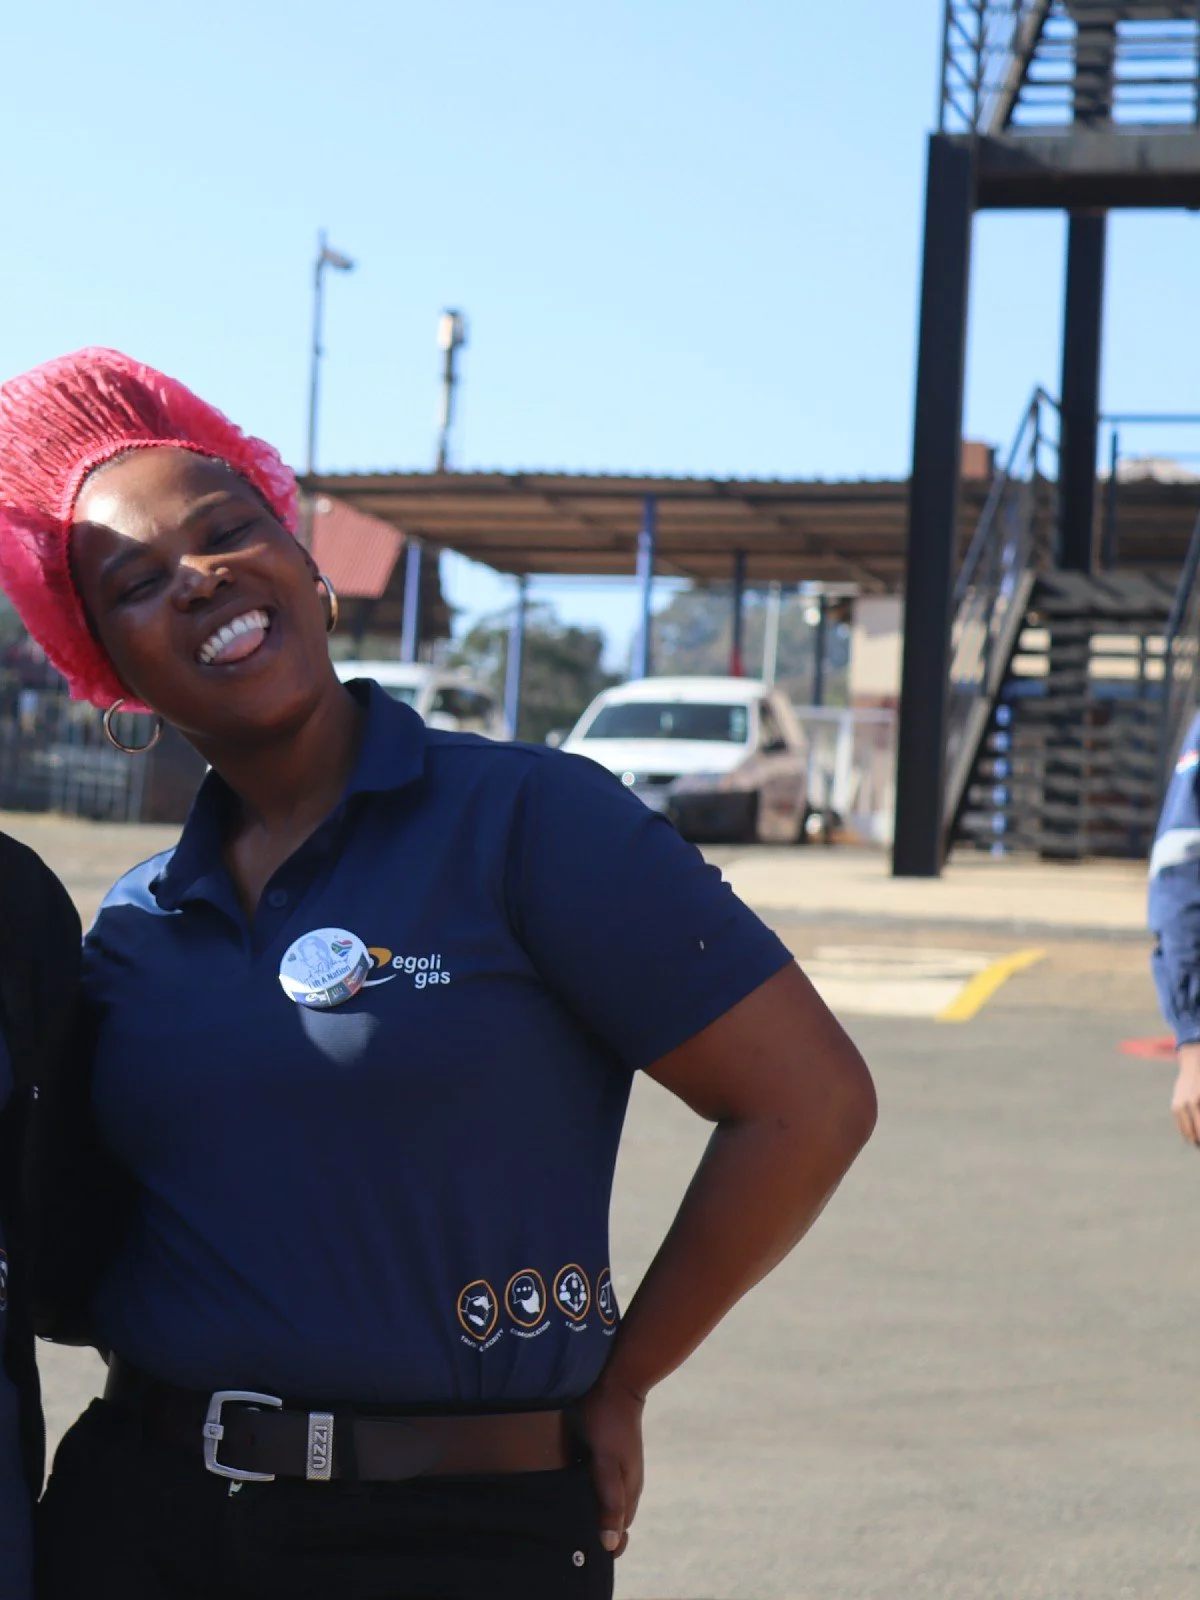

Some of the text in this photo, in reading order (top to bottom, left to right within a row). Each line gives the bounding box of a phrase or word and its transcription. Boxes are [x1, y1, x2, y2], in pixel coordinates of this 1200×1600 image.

[327, 965, 351, 981] Nation
[392, 954, 441, 974] egoli
[414, 972, 451, 989] gas
[313, 1426, 327, 1469] UZZI
